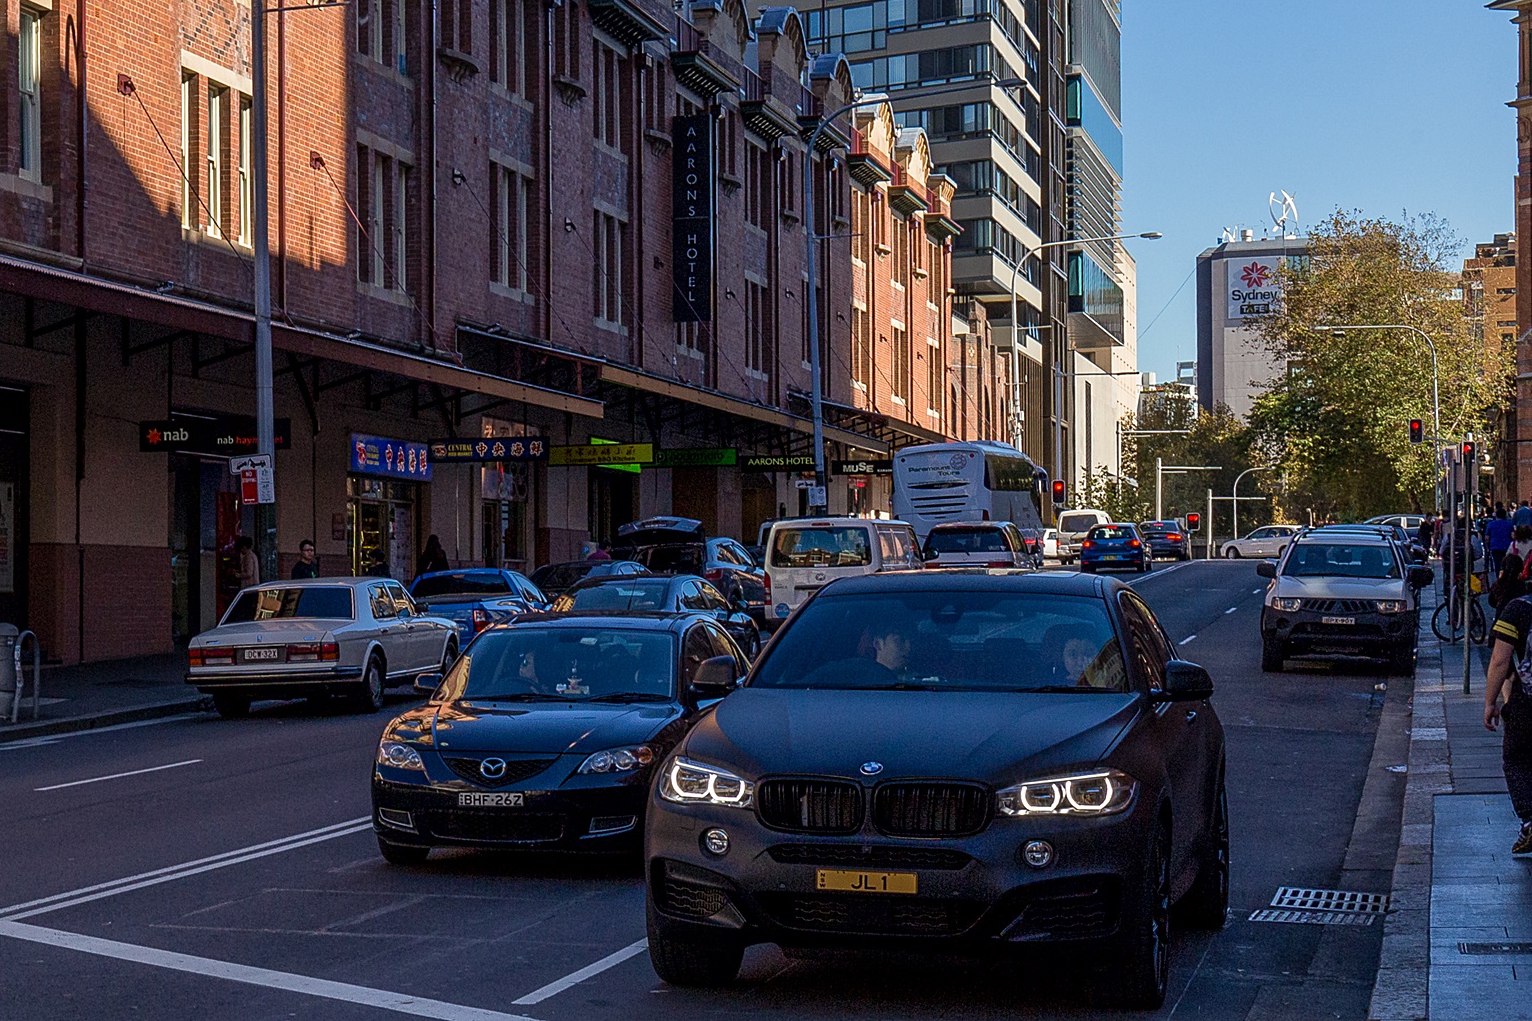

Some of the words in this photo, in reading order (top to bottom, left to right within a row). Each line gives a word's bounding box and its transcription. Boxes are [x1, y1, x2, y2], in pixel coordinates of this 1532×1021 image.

[686, 127, 698, 216] AARONS
[686, 234, 698, 302] HOTEL
[1232, 289, 1278, 303] Sydney
[163, 428, 189, 441] nab
[216, 435, 234, 445] nab
[448, 444, 473, 452] CENTRAL
[475, 441, 544, 458] 中央海鮮
[747, 457, 785, 466] AARONS
[786, 457, 815, 465] HOTEL
[842, 462, 874, 473] MUSE
